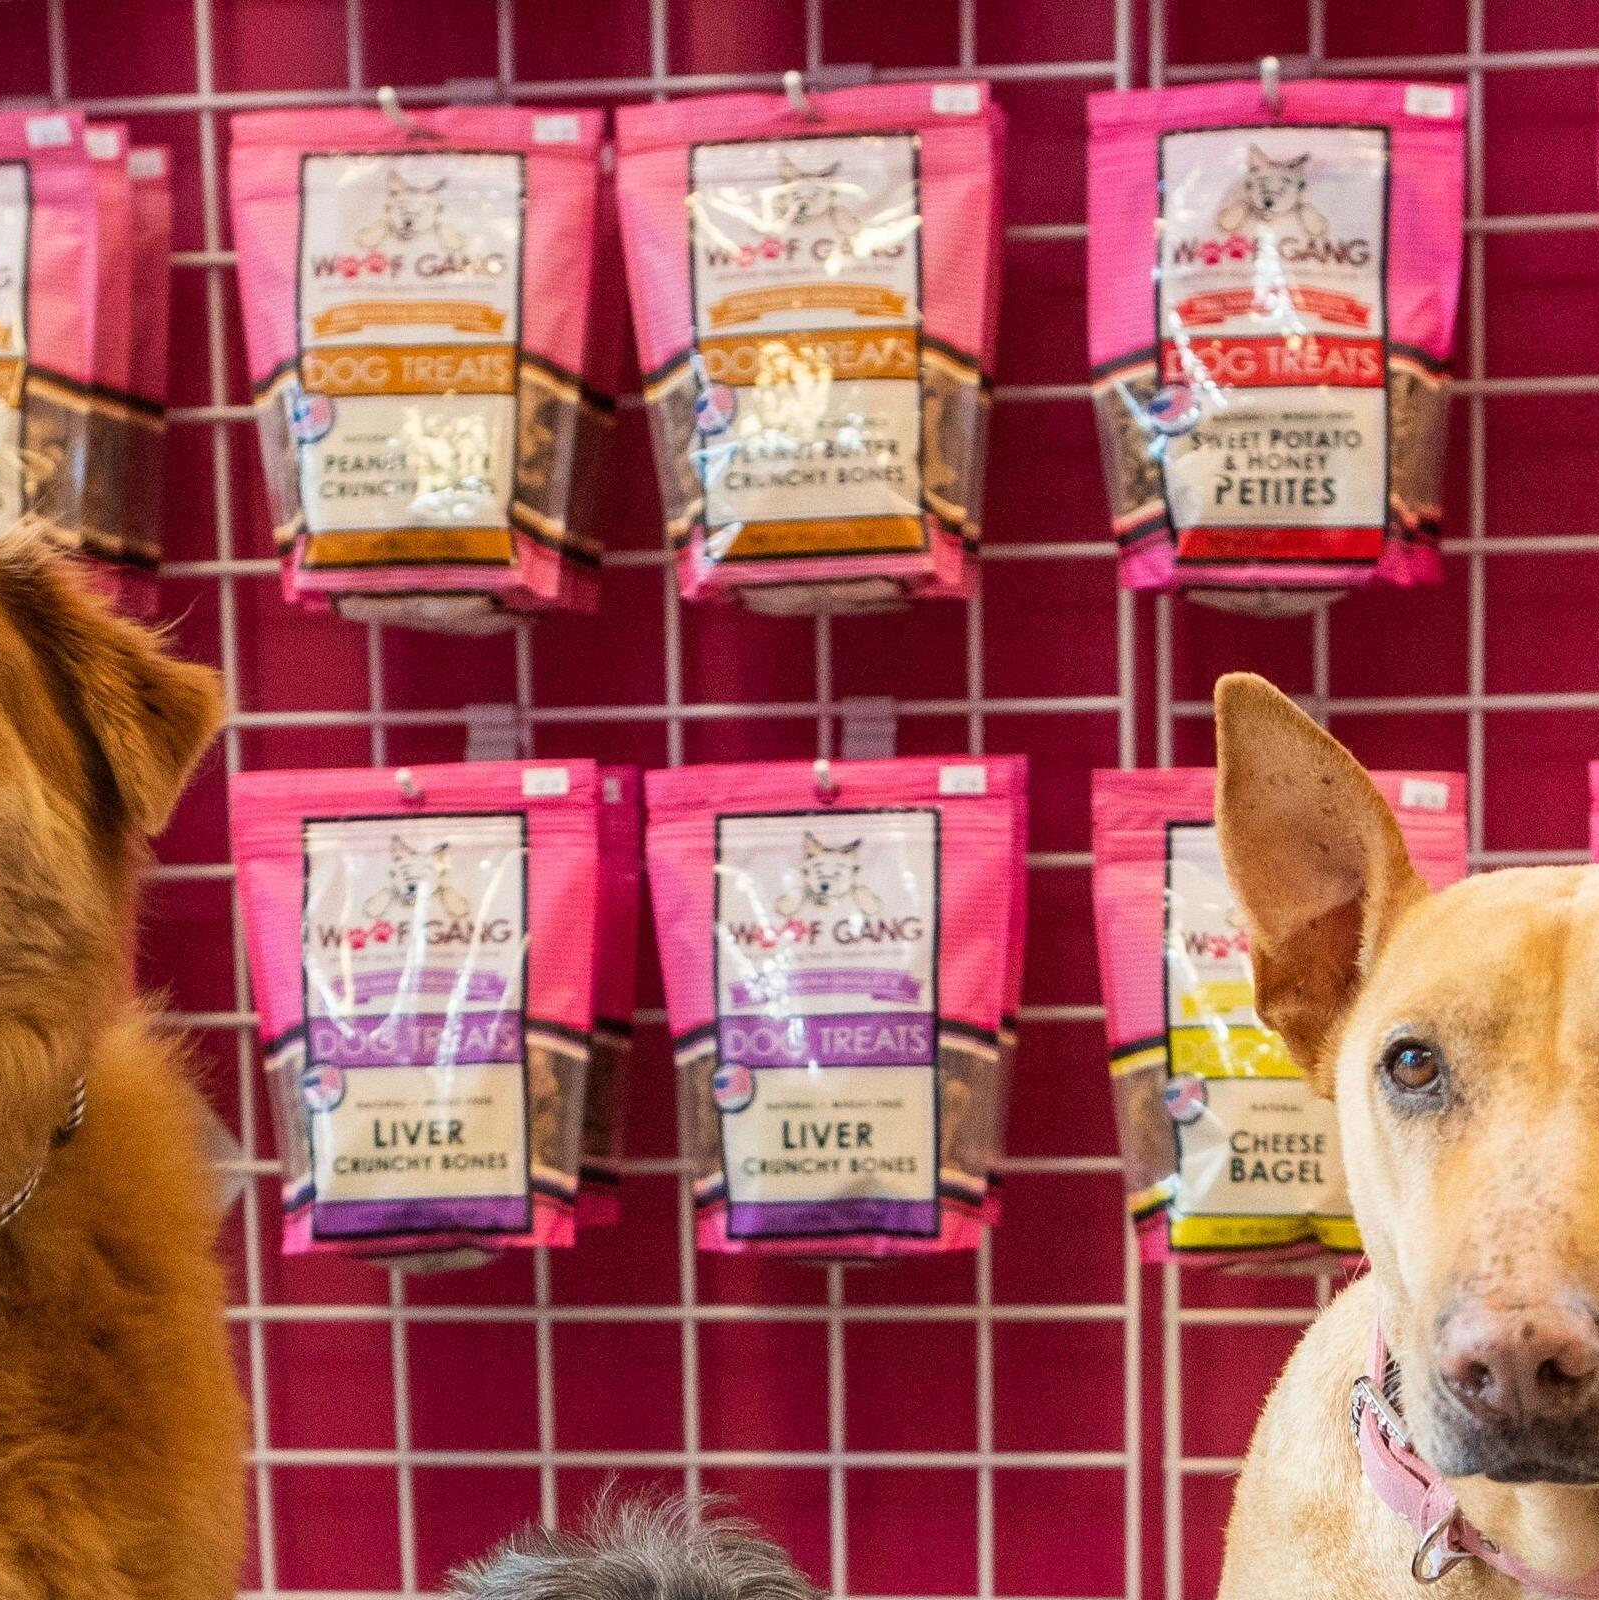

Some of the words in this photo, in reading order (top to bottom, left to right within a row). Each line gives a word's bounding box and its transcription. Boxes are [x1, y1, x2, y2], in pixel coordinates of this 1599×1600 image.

[1278, 235, 1370, 266] GANG
[304, 355, 389, 388] DOG
[403, 354, 510, 387] TREATS
[1269, 344, 1380, 379] TREATS
[1190, 430, 1261, 451] SWEET
[1269, 428, 1362, 451] POTATO
[1248, 451, 1330, 472] HONEY
[726, 469, 828, 491] CRUNCHY
[837, 464, 904, 485] BONES
[1215, 475, 1338, 507] PETITES
[318, 919, 409, 951] WOOF
[833, 915, 923, 944] GANG
[1185, 928, 1251, 960] WOO
[817, 1022, 931, 1056] TREATS
[373, 1117, 466, 1149] LIVER
[780, 1119, 874, 1150] LIVER
[1229, 1130, 1327, 1155] CHEESE
[333, 1155, 432, 1176] CRUNCHY
[441, 1151, 509, 1172] BONES
[742, 1156, 841, 1177] CRUNCHY
[848, 1155, 918, 1175] BONES
[1229, 1157, 1326, 1185] BAGEL
